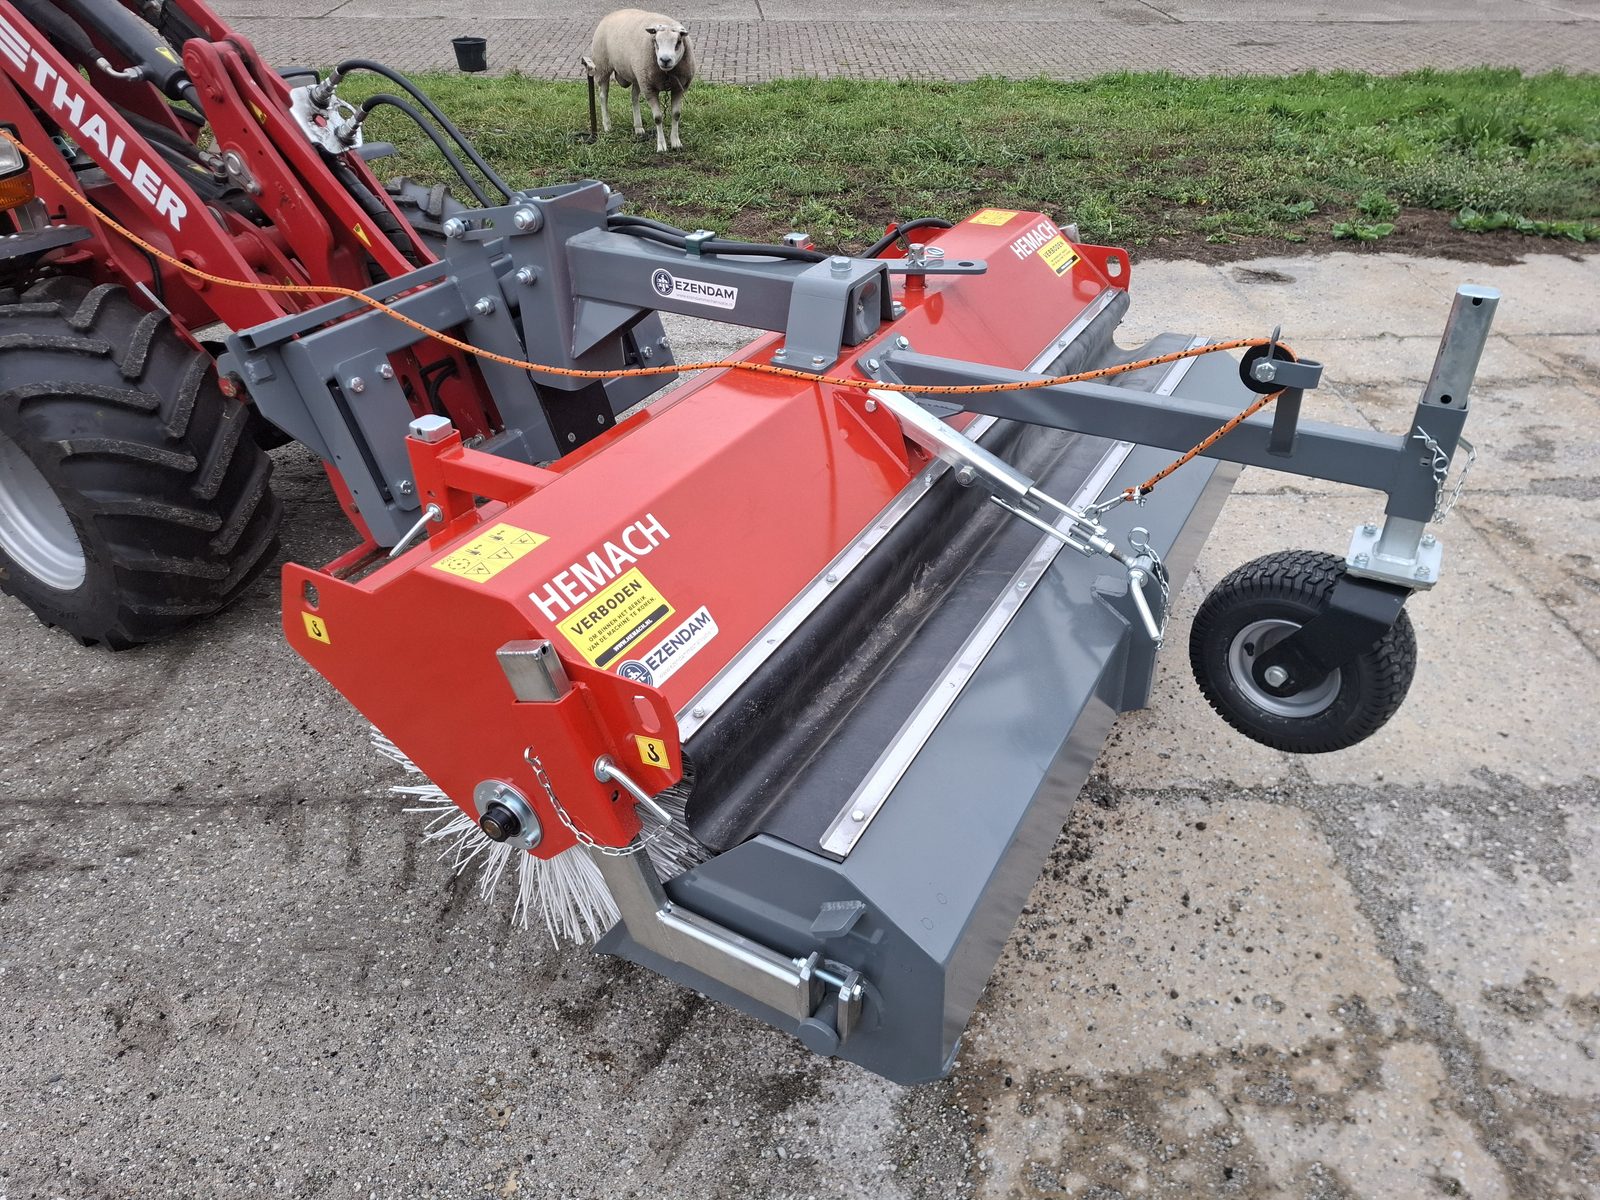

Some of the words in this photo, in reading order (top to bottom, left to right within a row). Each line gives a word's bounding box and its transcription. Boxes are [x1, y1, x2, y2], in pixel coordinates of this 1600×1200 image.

[1010, 220, 1057, 260] HEMACH
[675, 280, 735, 300] EZENDAM
[528, 513, 670, 622] HEMACH
[571, 579, 642, 635] VERBODEN
[588, 634, 598, 642] OM
[598, 618, 618, 635] BINNEN
[618, 609, 628, 620] HET
[628, 595, 647, 610] BEREIK
[587, 641, 600, 652] VAN
[600, 635, 608, 643] DE
[607, 617, 631, 637] MACHINE
[612, 618, 653, 652] WWW.HEMACH.NL
[645, 611, 711, 671] EZENDAM
